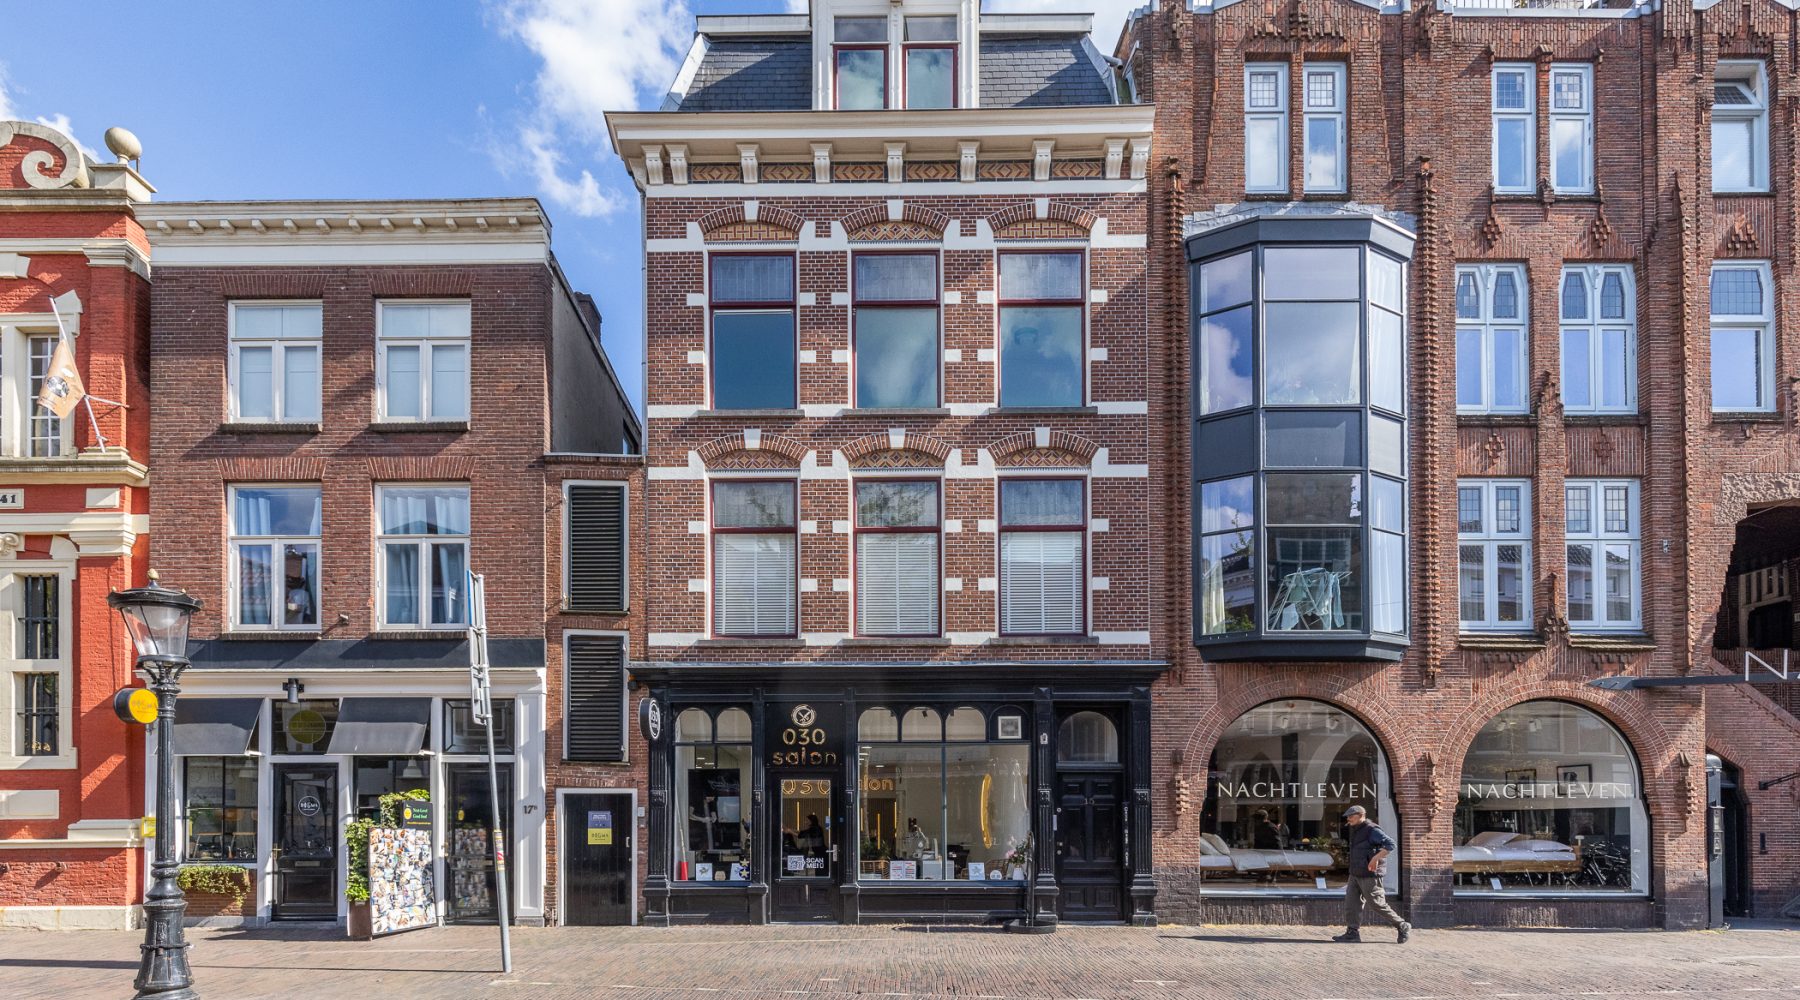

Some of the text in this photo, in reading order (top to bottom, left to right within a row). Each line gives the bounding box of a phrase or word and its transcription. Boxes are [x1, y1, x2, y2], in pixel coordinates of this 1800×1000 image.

[1745, 649, 1800, 681] N
[782, 728, 826, 745] 030
[772, 747, 837, 765] salon
[1217, 782, 1378, 799] NACHTLEVEN
[1467, 783, 1628, 799] NACHTLEVEN
